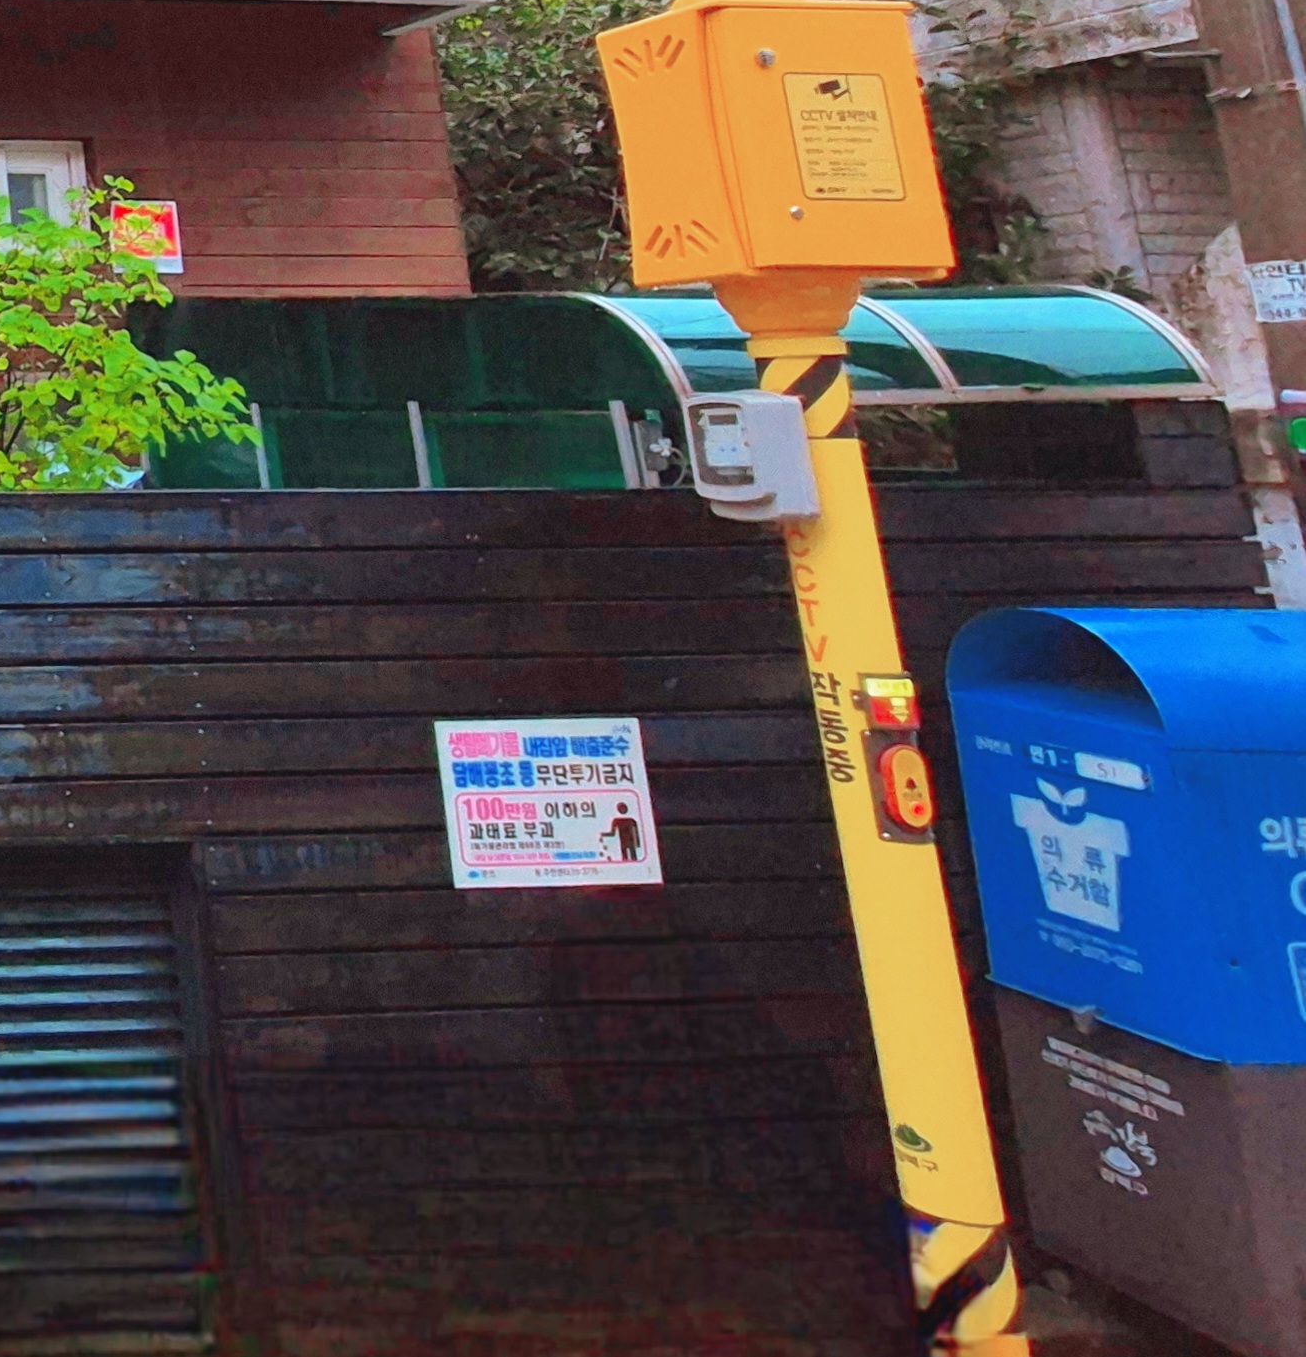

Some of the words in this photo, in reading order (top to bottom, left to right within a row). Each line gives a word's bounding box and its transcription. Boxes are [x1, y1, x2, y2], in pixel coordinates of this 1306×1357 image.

[537, 762, 635, 787] 무단투기금지
[462, 796, 538, 821] 100만원
[544, 800, 597, 820] 이하의
[469, 822, 518, 841] 과태료
[523, 821, 555, 840] 부과
[1046, 865, 1110, 908] 수거함
